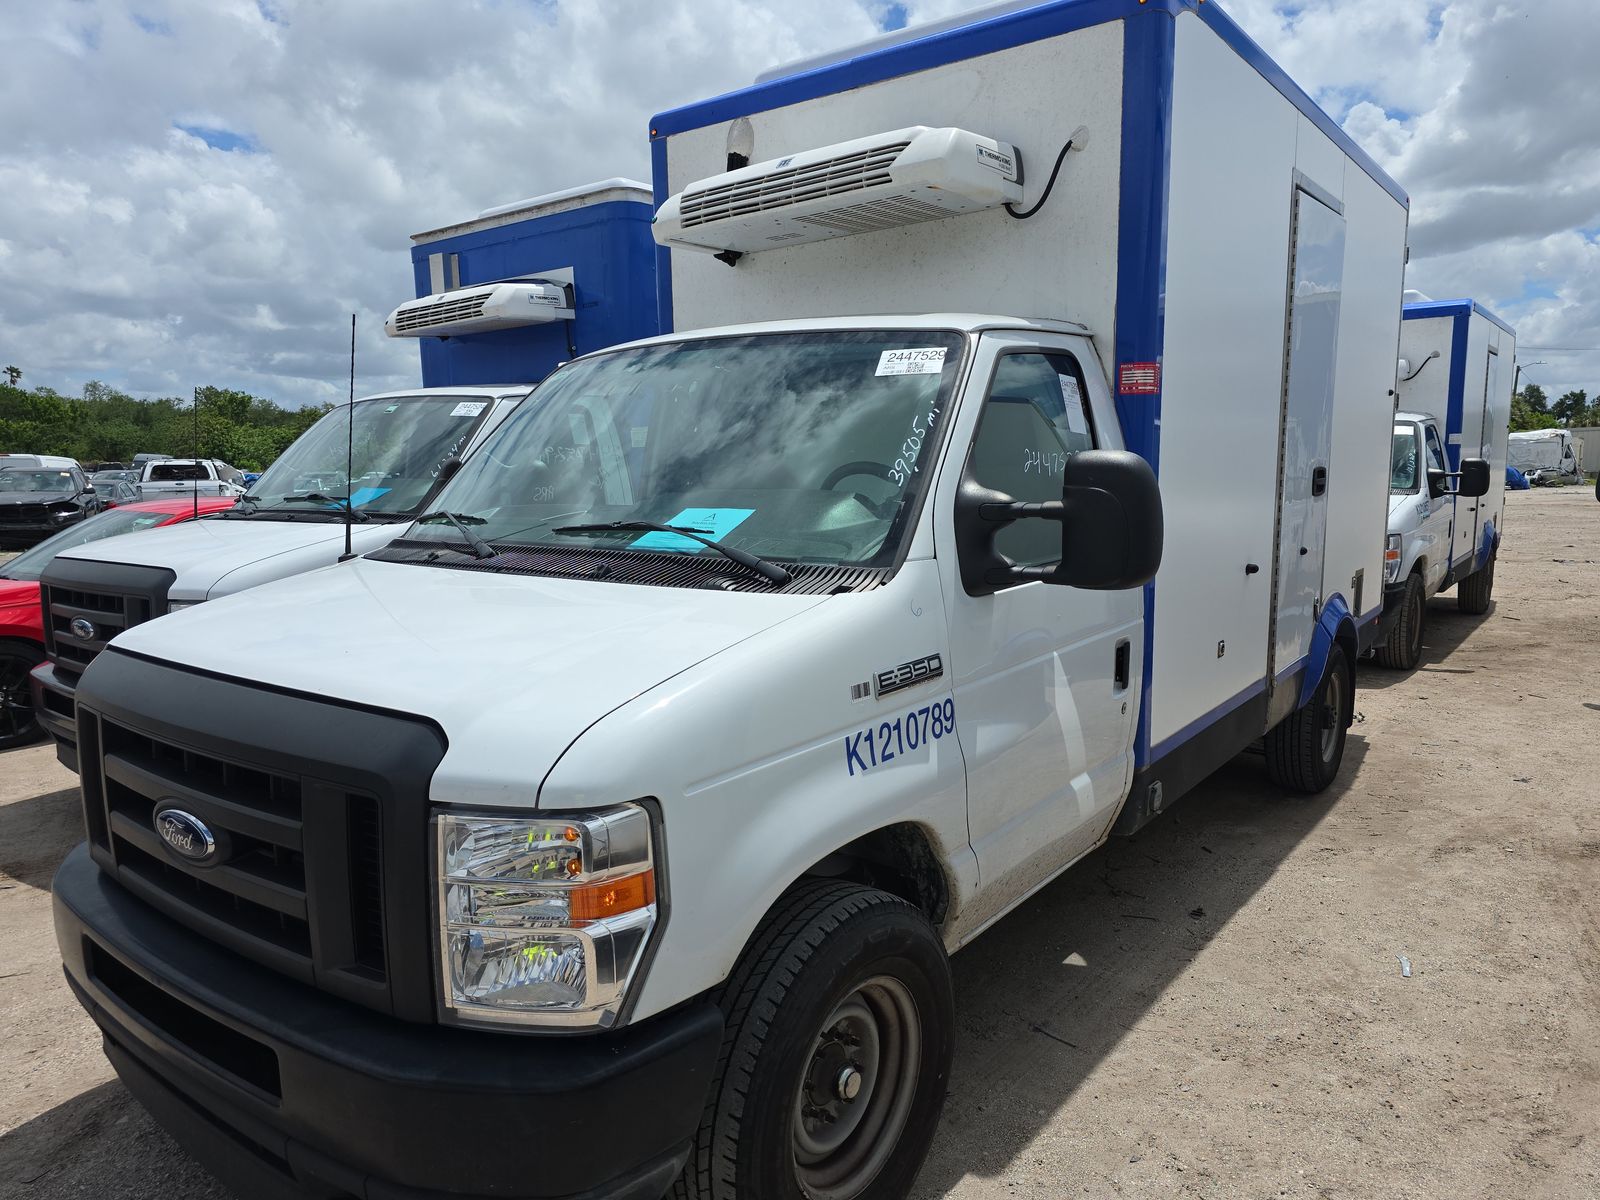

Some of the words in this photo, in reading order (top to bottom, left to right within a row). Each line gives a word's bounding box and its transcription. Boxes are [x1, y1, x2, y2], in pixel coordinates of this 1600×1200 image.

[887, 350, 946, 363] 2447529
[1024, 448, 1080, 477] 24475
[845, 698, 955, 777] K1210789
[163, 817, 193, 850] Ford
